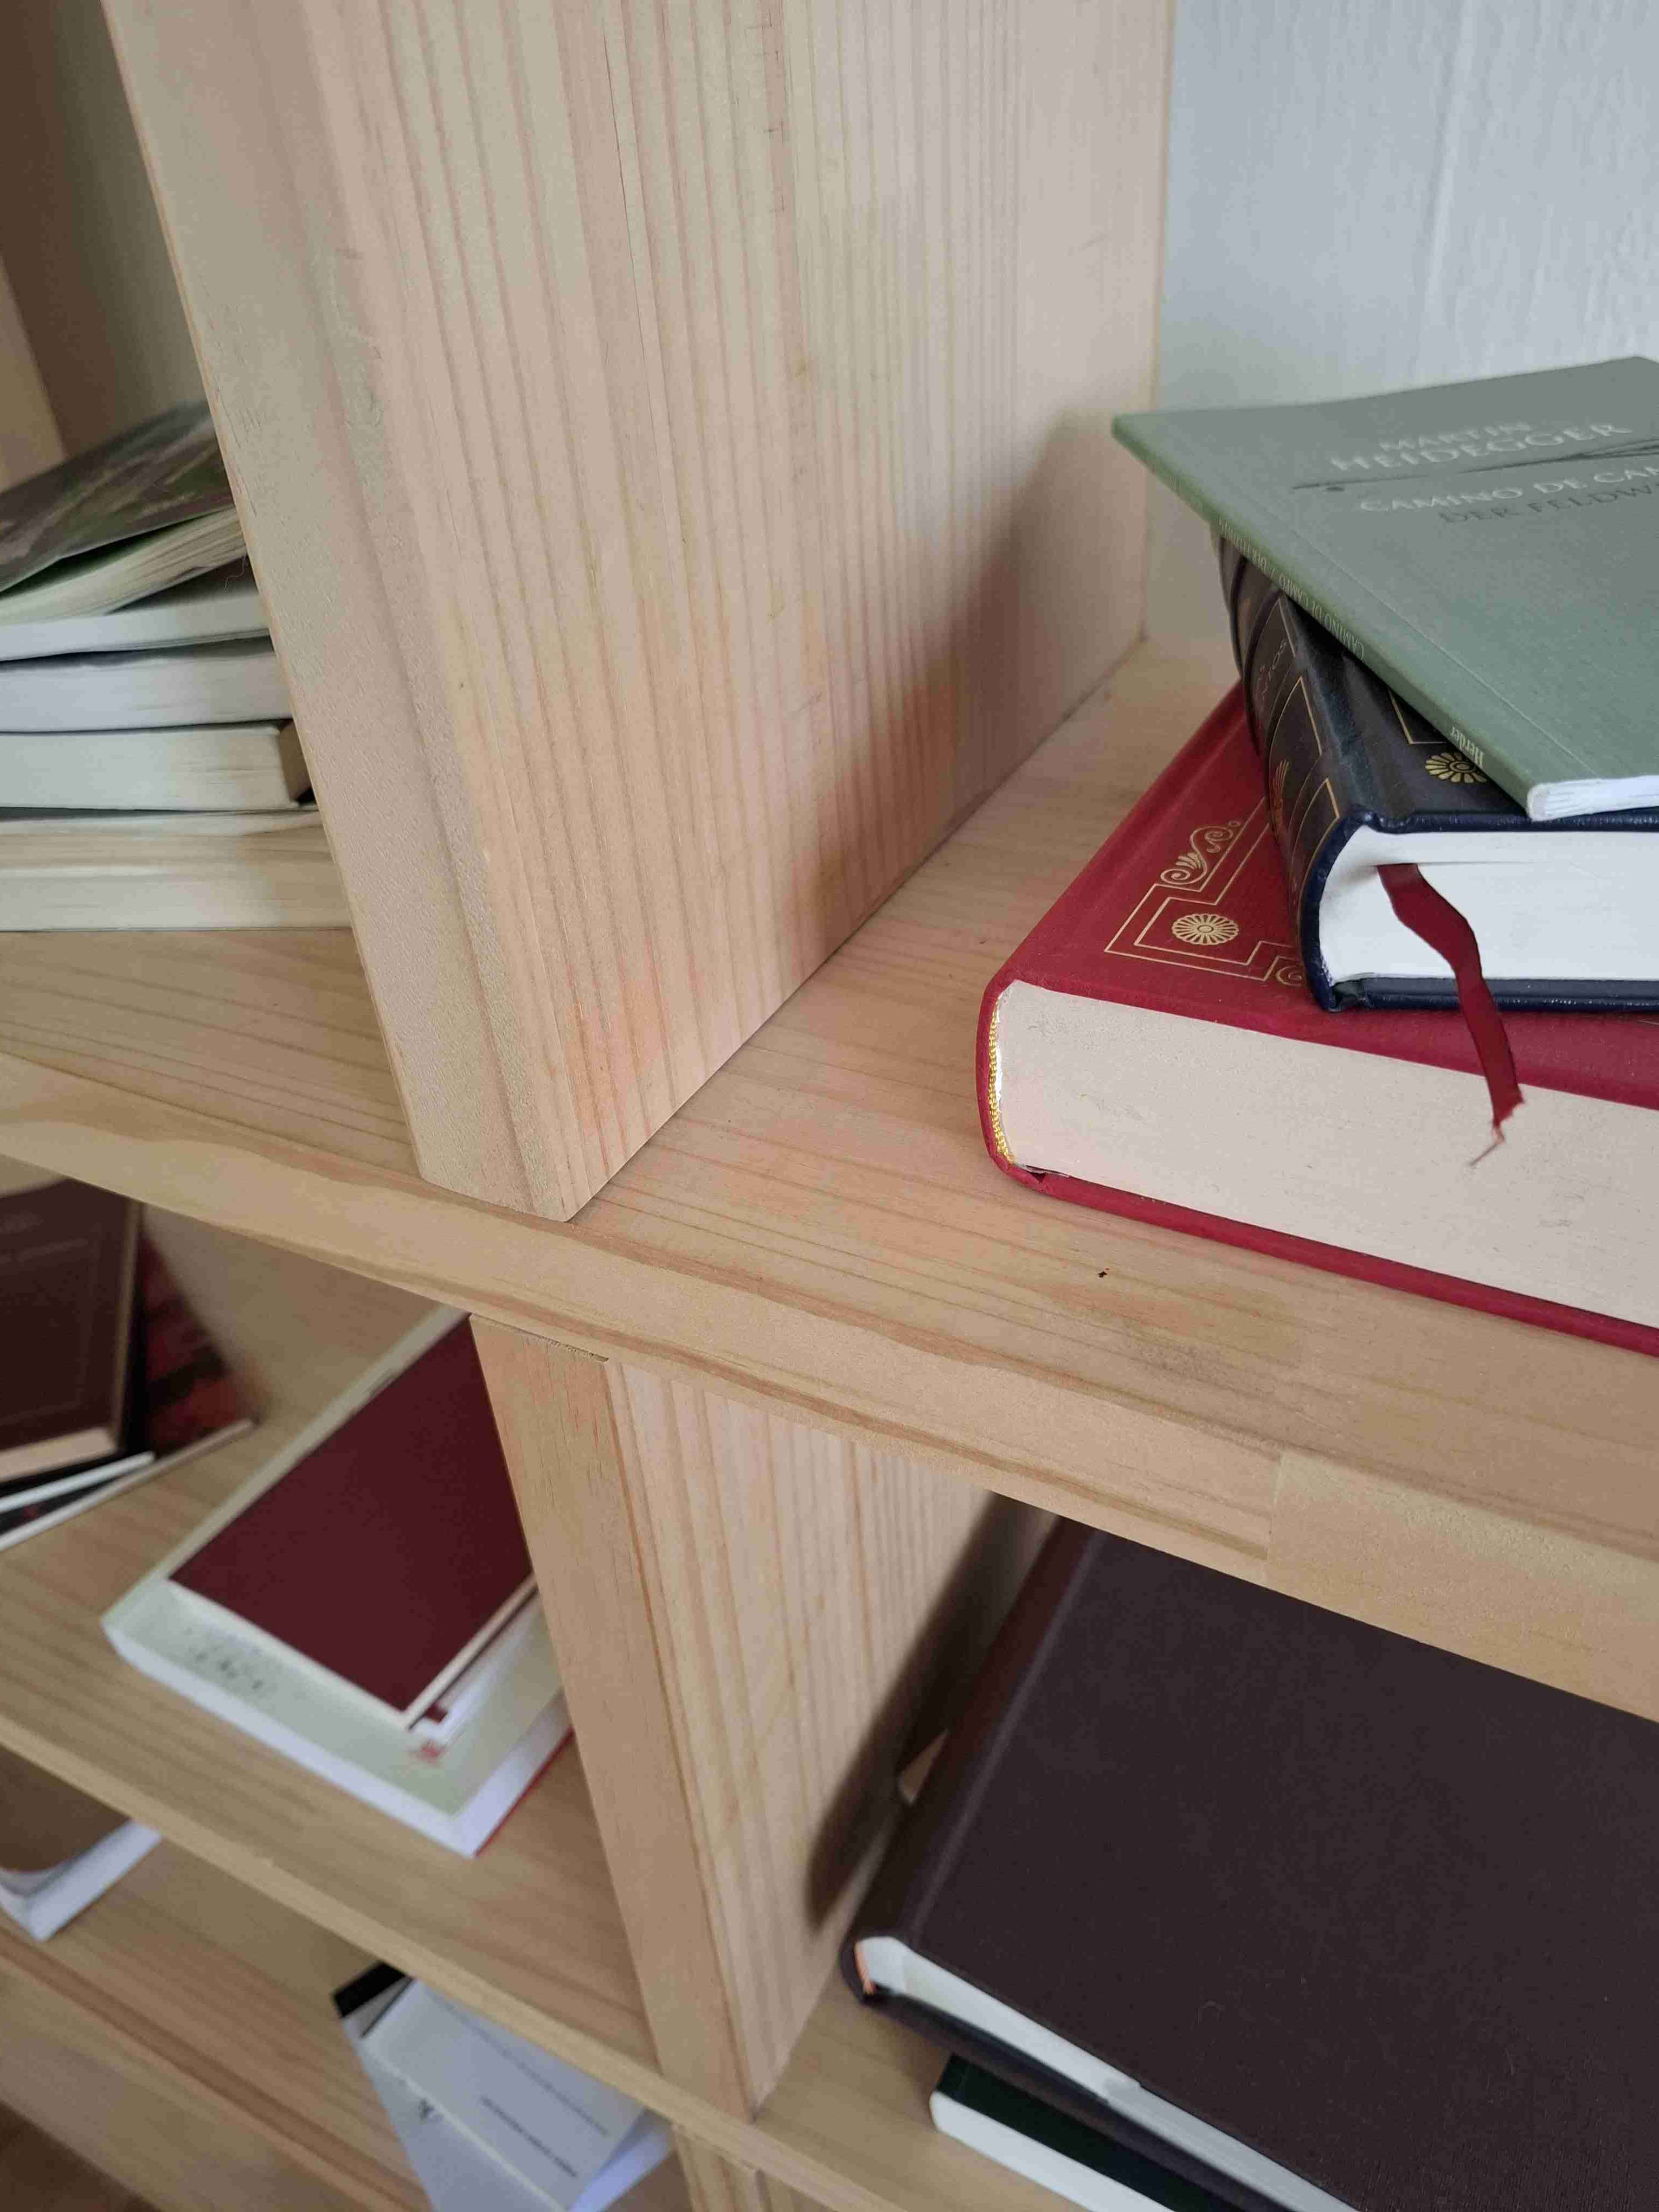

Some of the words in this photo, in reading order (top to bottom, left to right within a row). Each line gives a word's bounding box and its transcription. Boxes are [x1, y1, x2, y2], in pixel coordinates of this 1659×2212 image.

[1330, 424, 1633, 471] HEIDEGGER
[1360, 488, 1523, 511] CAMINO
[1533, 478, 1589, 493] DE
[1438, 507, 1520, 523] DER
[1323, 612, 1365, 661] CAMINO
[1450, 723, 1484, 770] Herder
